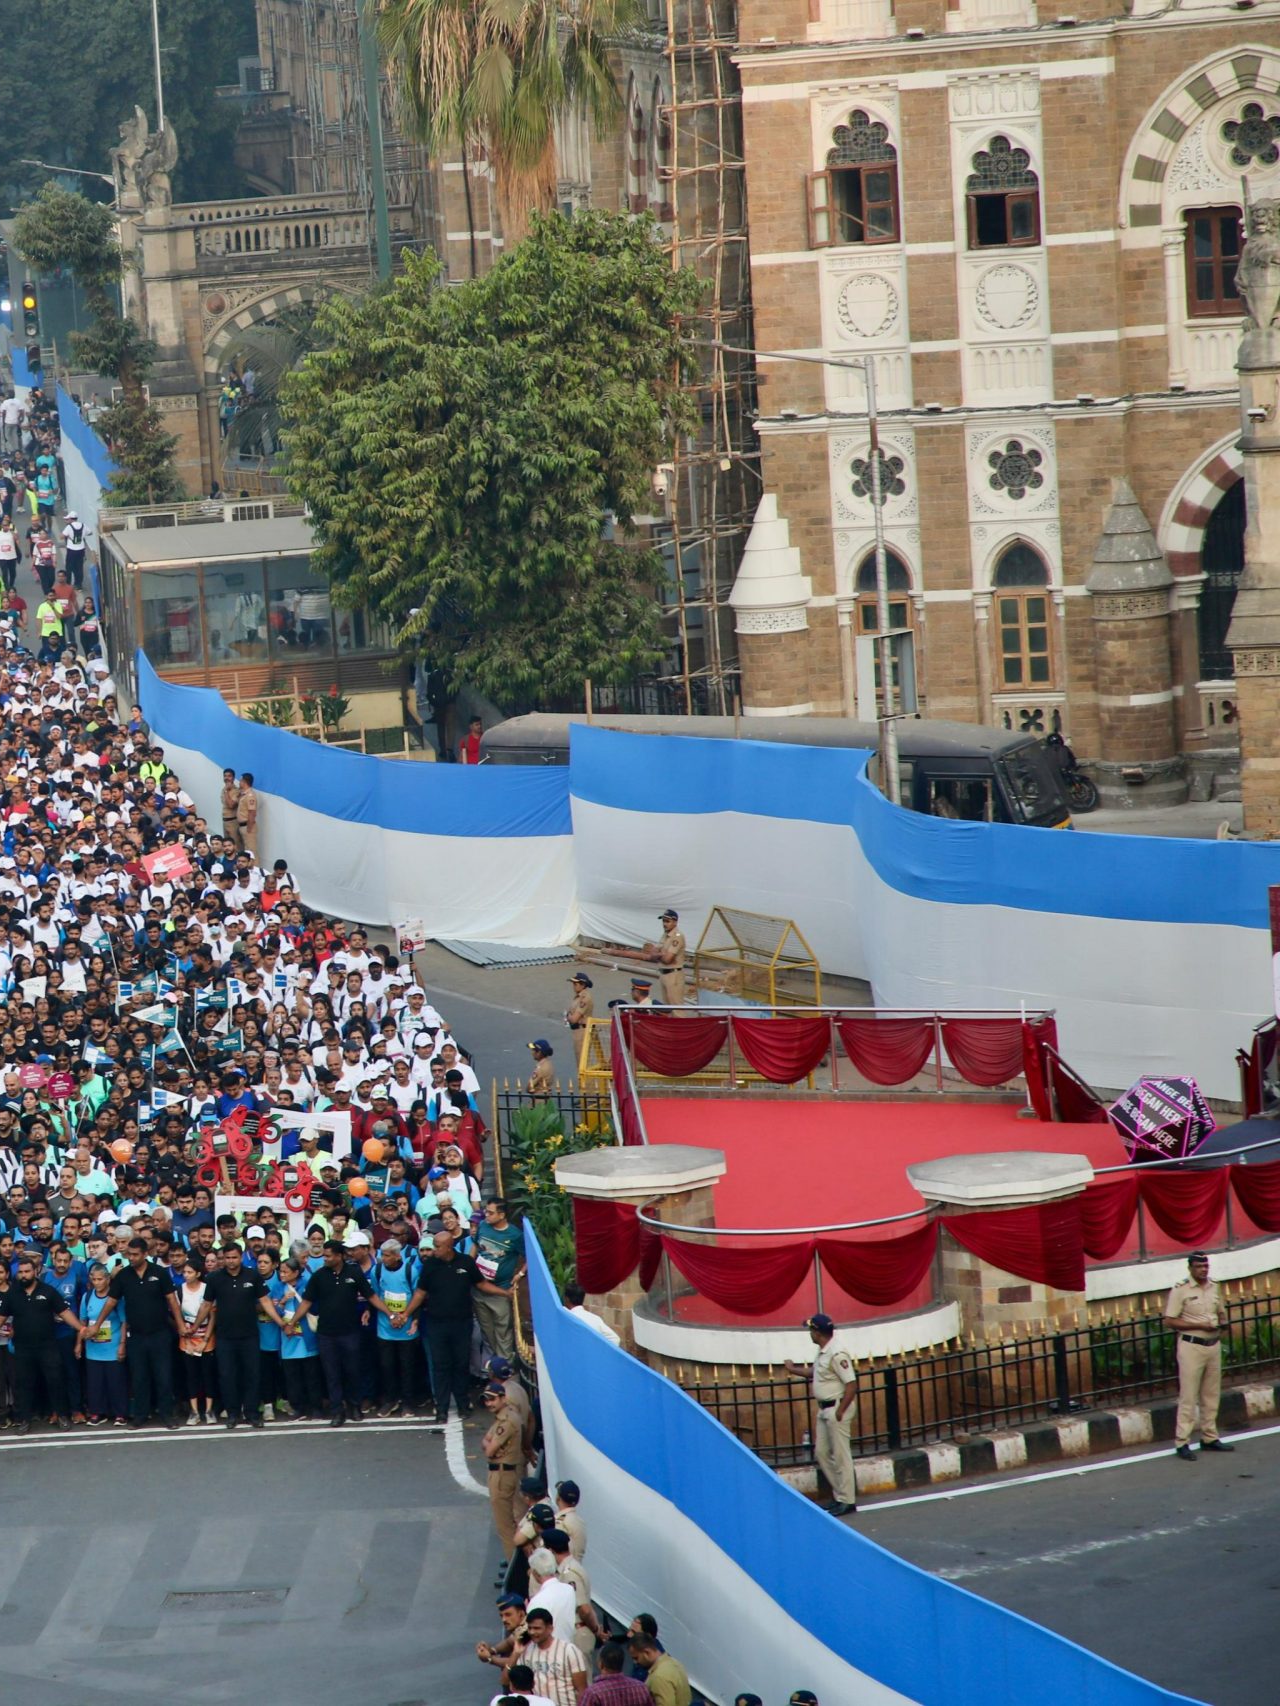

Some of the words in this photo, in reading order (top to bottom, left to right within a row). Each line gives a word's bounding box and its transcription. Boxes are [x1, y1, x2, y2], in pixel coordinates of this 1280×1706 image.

[1129, 1106, 1157, 1133] BEGAN
[1151, 1129, 1179, 1149] HERE
[1135, 1087, 1163, 1111] BEGAN
[1159, 1105, 1184, 1128] HERE
